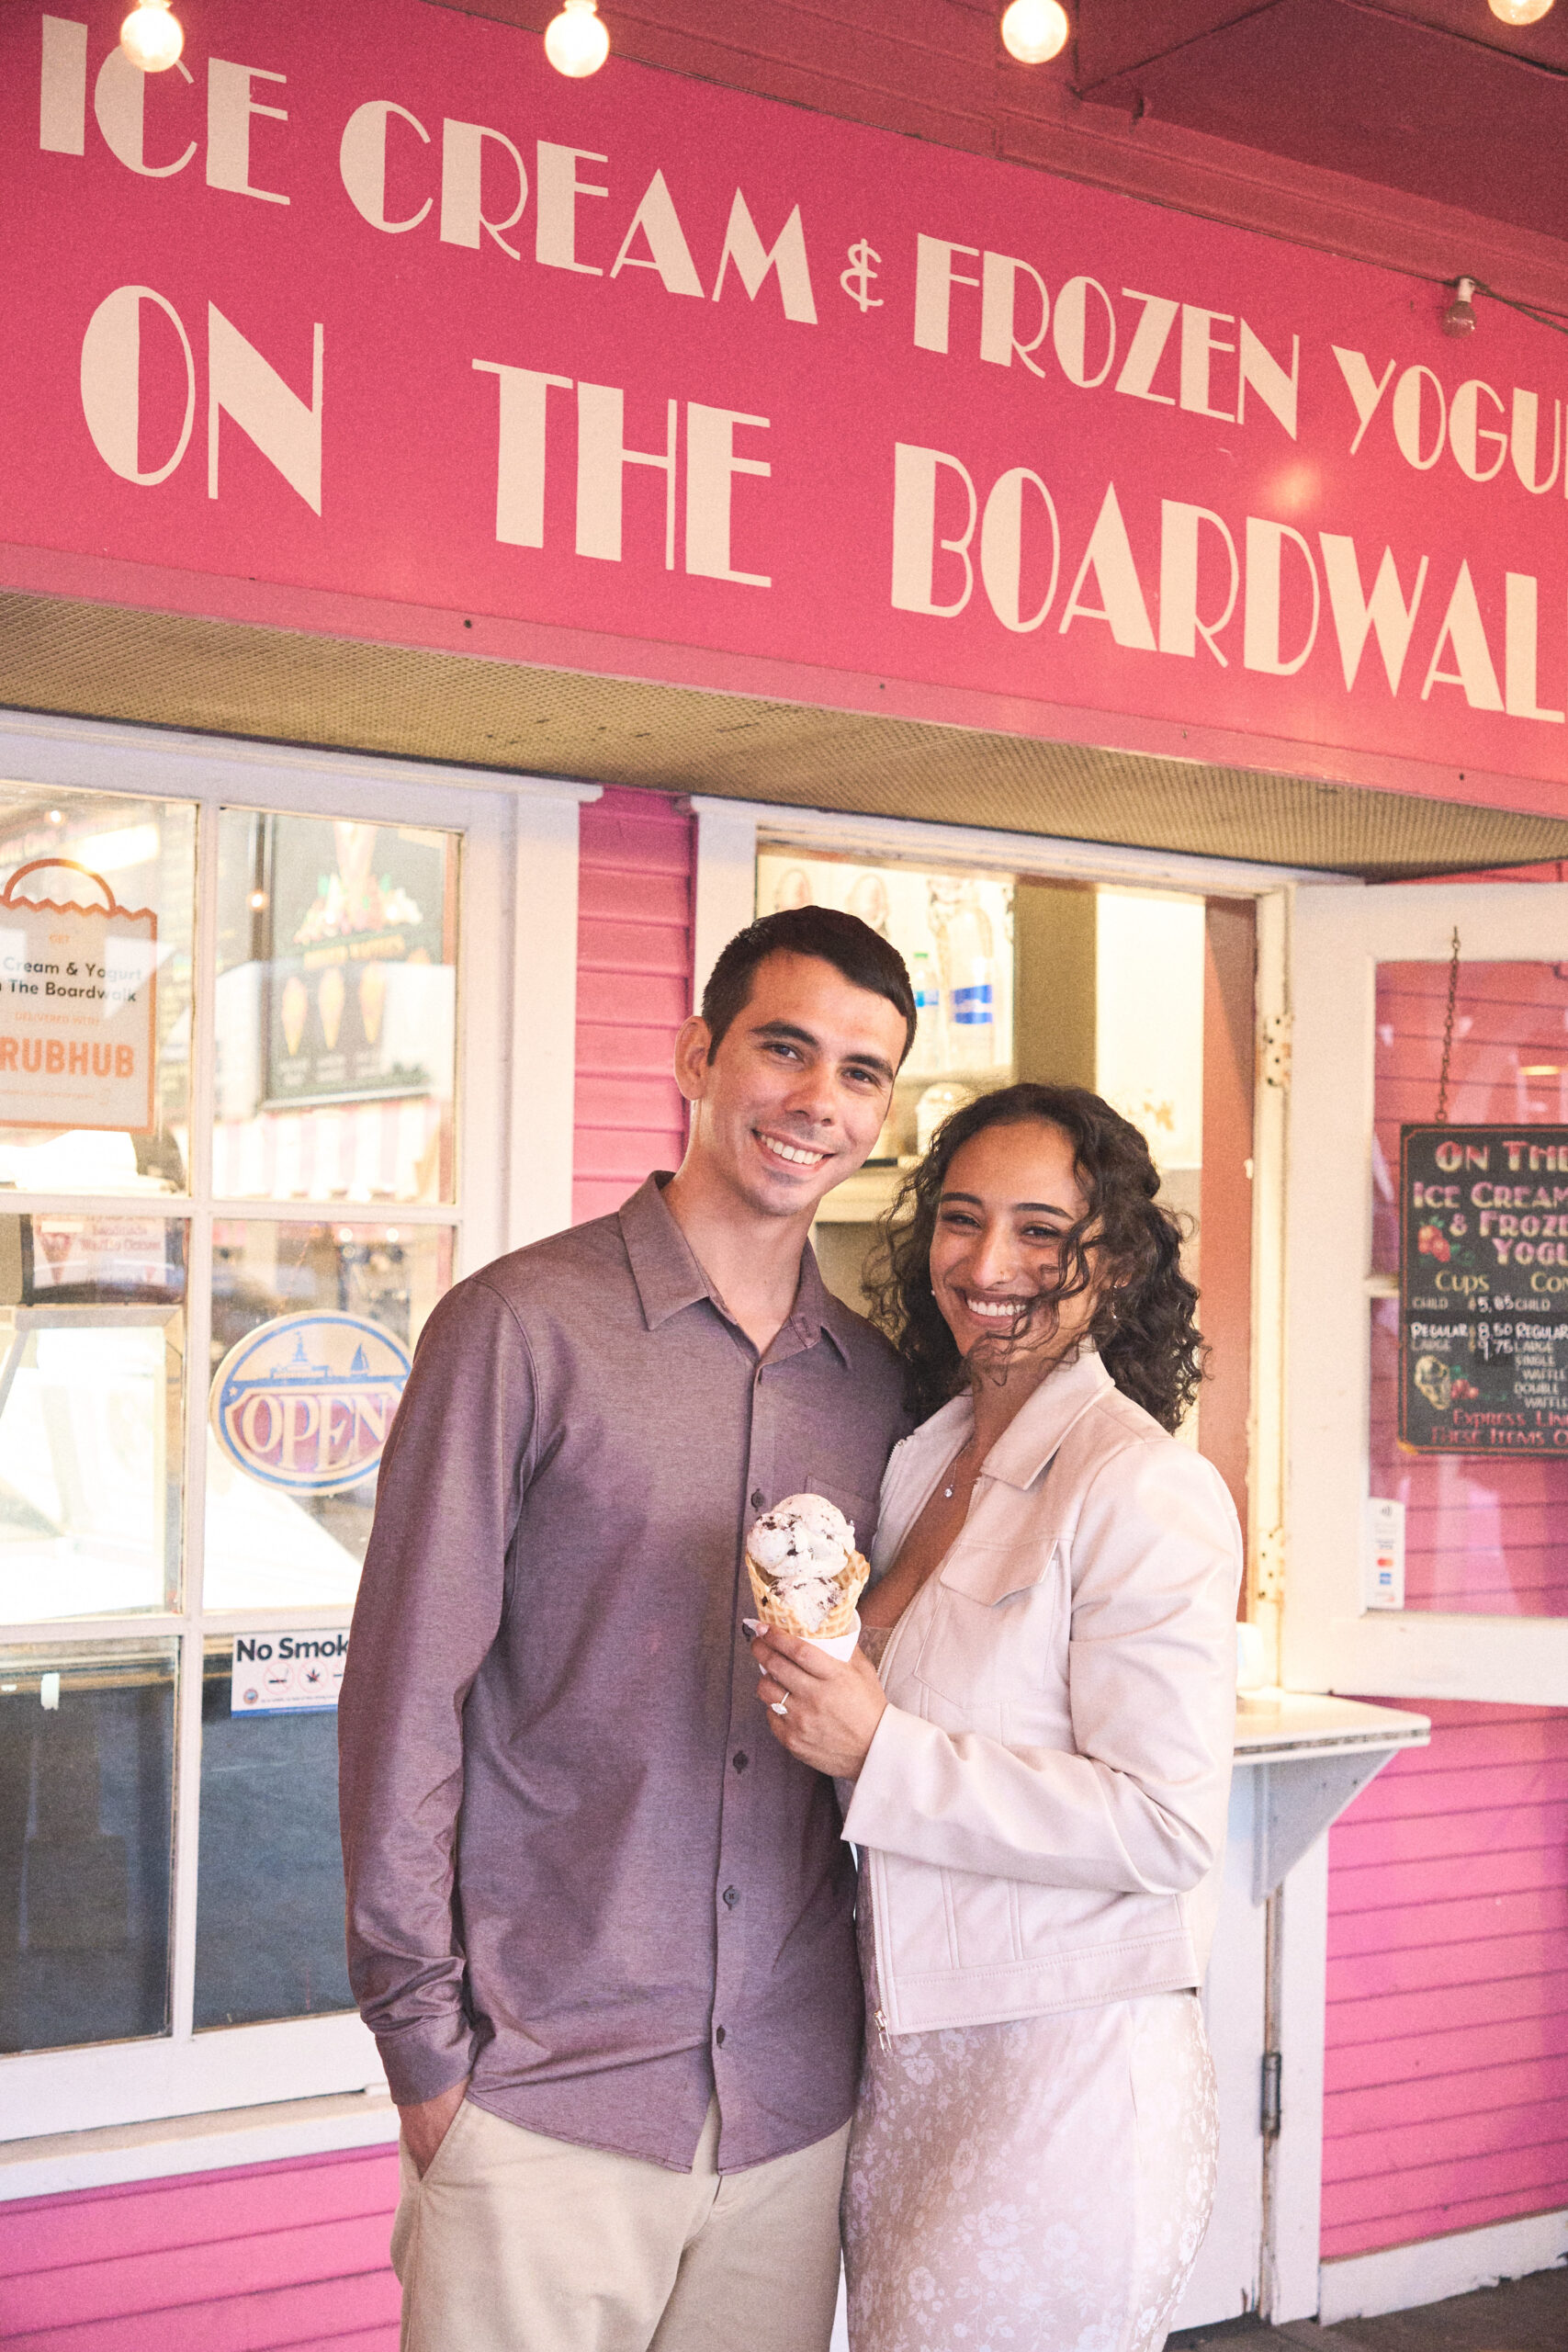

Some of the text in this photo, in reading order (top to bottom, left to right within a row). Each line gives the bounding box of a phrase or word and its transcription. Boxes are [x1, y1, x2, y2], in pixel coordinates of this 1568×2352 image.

[40, 14, 1568, 500] ICE CREAM & FROZEN YOGU
[80, 285, 1566, 724] ON THE BOARDWAL
[4, 956, 141, 982] Cream & Yogurt
[8, 979, 136, 1001] The Boardwalk
[1436, 1141, 1489, 1171] ON
[1413, 1182, 1461, 1208] ICE
[1435, 1270, 1490, 1296] Cups
[242, 1394, 390, 1471] OPEN
[236, 1639, 274, 1662] No
